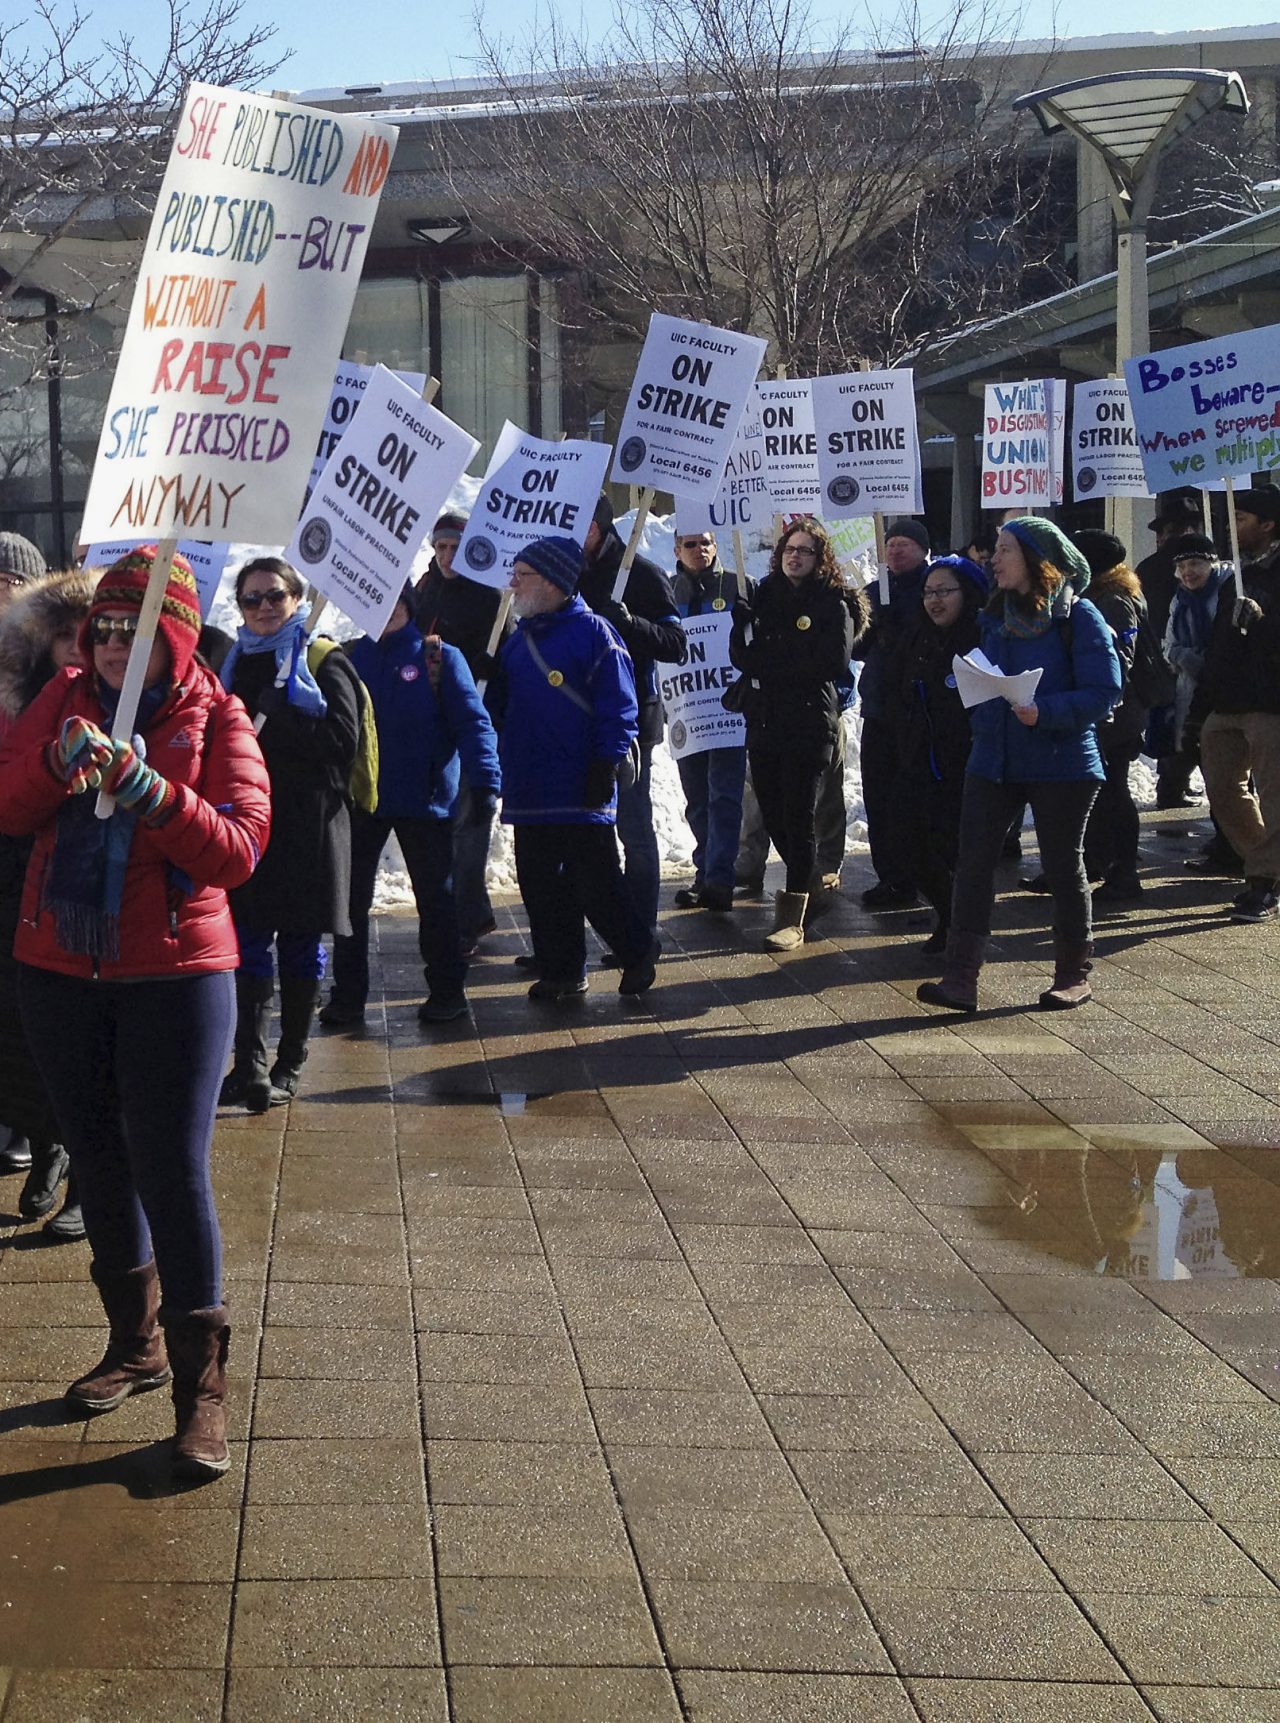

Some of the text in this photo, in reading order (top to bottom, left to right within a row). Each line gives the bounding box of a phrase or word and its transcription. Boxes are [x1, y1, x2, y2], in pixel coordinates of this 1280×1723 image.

[177, 96, 390, 197] SHE PUBLISHED AND
[144, 275, 266, 331] WITHOUT A
[671, 332, 738, 356] UIC FACULTY
[150, 338, 293, 405] RAISE
[671, 354, 713, 387] ON
[1138, 352, 1237, 394] Bosses
[769, 391, 808, 400] FACULTY
[839, 382, 894, 394] UIC FACULTY
[993, 382, 1045, 413] WHAT'S
[637, 384, 731, 429] STRIKE
[763, 407, 794, 428] ON
[852, 398, 884, 422] ON
[1096, 403, 1125, 422] ON
[104, 405, 158, 462] SHE
[166, 411, 291, 463] PERISHED
[386, 399, 446, 450] UIC FACULTY
[636, 421, 715, 445] FOR A FAIR CONTRACT
[1079, 427, 1139, 449] STRIK
[1140, 400, 1280, 454] When screwed
[520, 447, 582, 461] UIC FACULTY
[765, 434, 817, 457] RIKE
[828, 427, 905, 455] STRIKE
[987, 438, 1046, 464] UNION
[377, 432, 418, 483] ON
[650, 454, 681, 473] Local
[683, 463, 712, 478] 6456
[725, 449, 762, 478] AND
[1169, 454, 1206, 476] we
[521, 469, 559, 493] ON
[731, 476, 767, 495] BETTER
[770, 486, 820, 496] Local 6456
[866, 483, 909, 492] Local 6456
[110, 475, 246, 529] ANYWAY
[335, 455, 422, 545] STRIKE
[486, 487, 579, 531] STRIKE
[709, 497, 751, 526] UIC
[322, 494, 345, 518] UNFAIR
[343, 514, 365, 537] LABOR
[364, 532, 400, 568] PRACTICES
[485, 522, 499, 533] FOR
[100, 548, 130, 556] UNFAIR
[331, 553, 360, 583] Local
[359, 578, 384, 604] 6456
[662, 666, 734, 701] STRIKE
[690, 719, 743, 733] Local 6456
